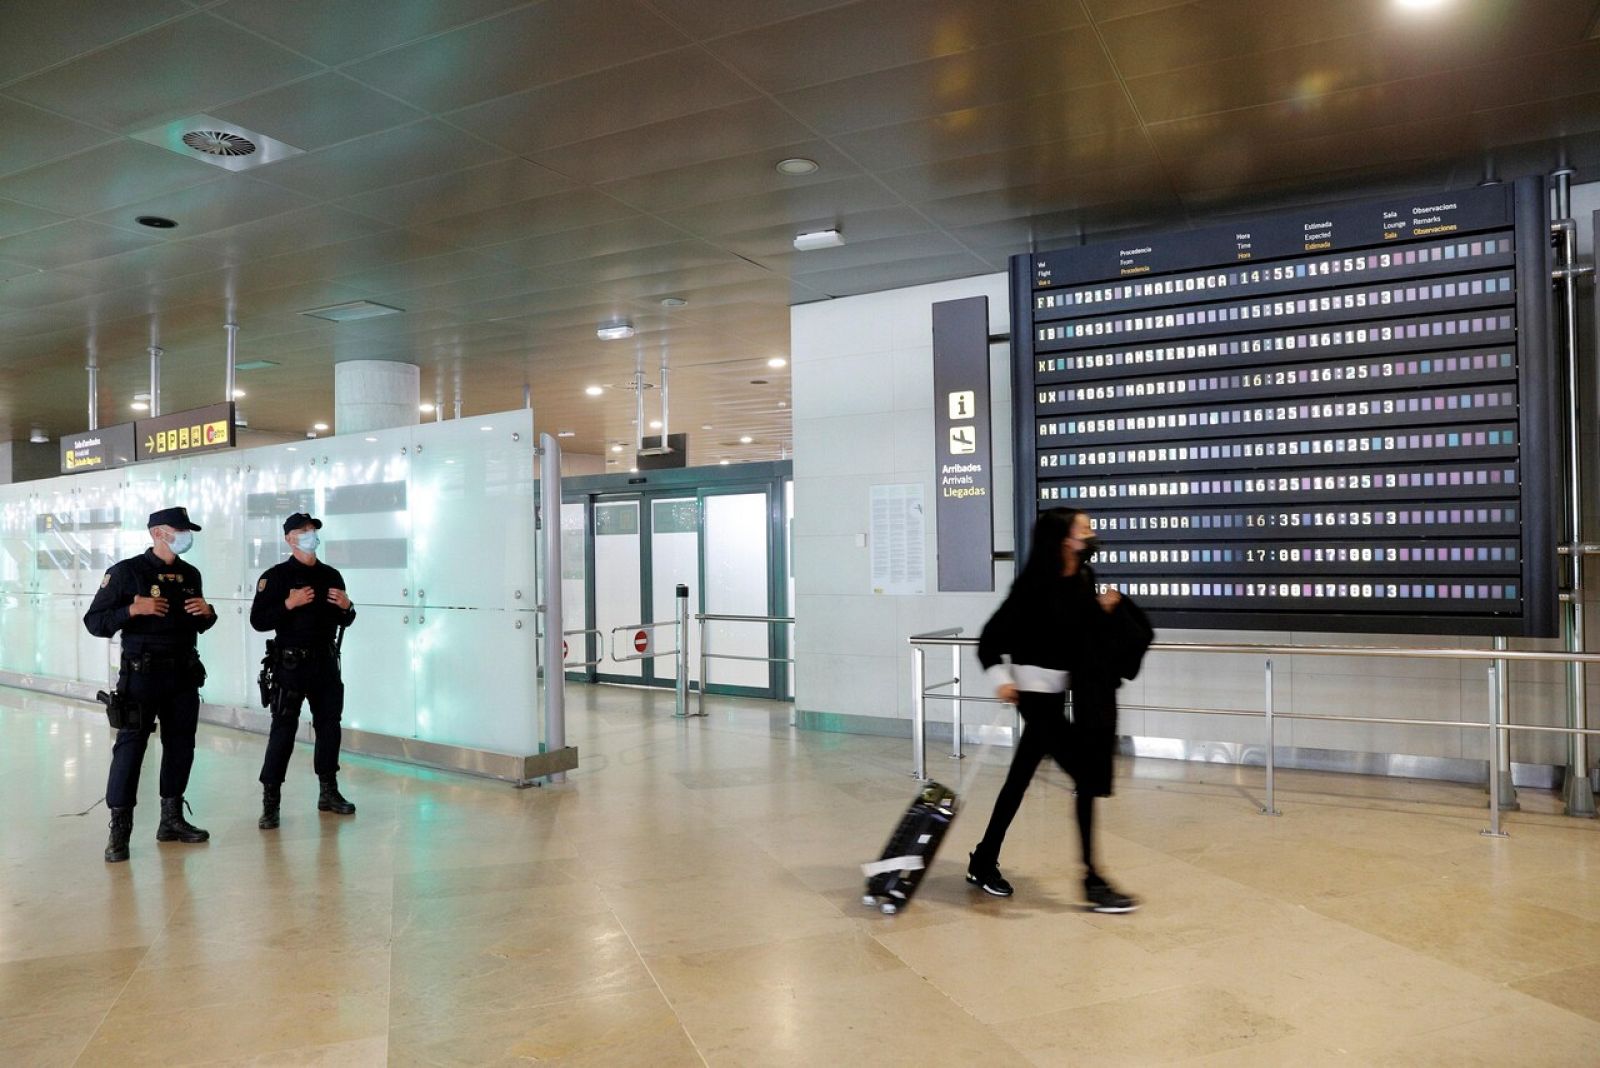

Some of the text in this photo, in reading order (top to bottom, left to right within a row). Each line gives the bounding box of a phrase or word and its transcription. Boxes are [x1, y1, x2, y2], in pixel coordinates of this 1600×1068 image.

[1412, 203, 1457, 214] Observacions
[1304, 222, 1332, 230] Estimada
[1383, 221, 1406, 229] Lounge
[1413, 216, 1440, 225] Remarks
[1305, 232, 1331, 240] Expected
[1414, 225, 1457, 235] Observaciones
[1037, 295, 1054, 308] FR
[1075, 289, 1112, 304] 7215
[1240, 267, 1295, 284] 14:55
[1309, 257, 1366, 276] 14:55
[1381, 255, 1391, 267] 3
[1039, 291, 1391, 341] IB 8431 IBIZA 15:55 15:55 3
[1039, 360, 1055, 371] KL
[1125, 344, 1217, 363] AMSTERDAM
[1241, 336, 1295, 353] 16:10
[1309, 329, 1366, 347] 16:10
[1381, 327, 1391, 340] 3
[1039, 364, 1392, 403] UX 4065 MADRID 16:25 16:25 3
[1127, 415, 1186, 430] MADRID
[1243, 407, 1297, 423] 16:25
[1311, 402, 1368, 418] 16:25
[1384, 400, 1393, 413] 3
[1040, 455, 1058, 467] AZ
[1127, 448, 1187, 462] MADRID
[1244, 442, 1298, 455] 16:25
[1313, 438, 1370, 454] 16:25
[1384, 437, 1394, 450] 3
[942, 463, 981, 474] Arribades
[943, 475, 973, 485] Arrivals
[1129, 481, 1188, 496] MADRID
[1245, 478, 1299, 492] 16:25
[1314, 475, 1371, 490] 16:25
[1386, 475, 1395, 487] 3
[944, 486, 985, 498] Llegadas
[1130, 517, 1189, 529] LISBOA
[1247, 513, 1300, 527] 16:35
[1315, 512, 1371, 526] 16:35
[1386, 512, 1396, 524] 3
[1130, 551, 1189, 562] MADRID
[1247, 550, 1300, 562] 17:00
[1315, 549, 1372, 562] 17:00
[1387, 549, 1396, 561] 3
[1130, 584, 1189, 595] MADRID
[1247, 584, 1300, 595] 17:00
[1315, 584, 1372, 597] 17:00
[1387, 585, 1397, 598] 3
